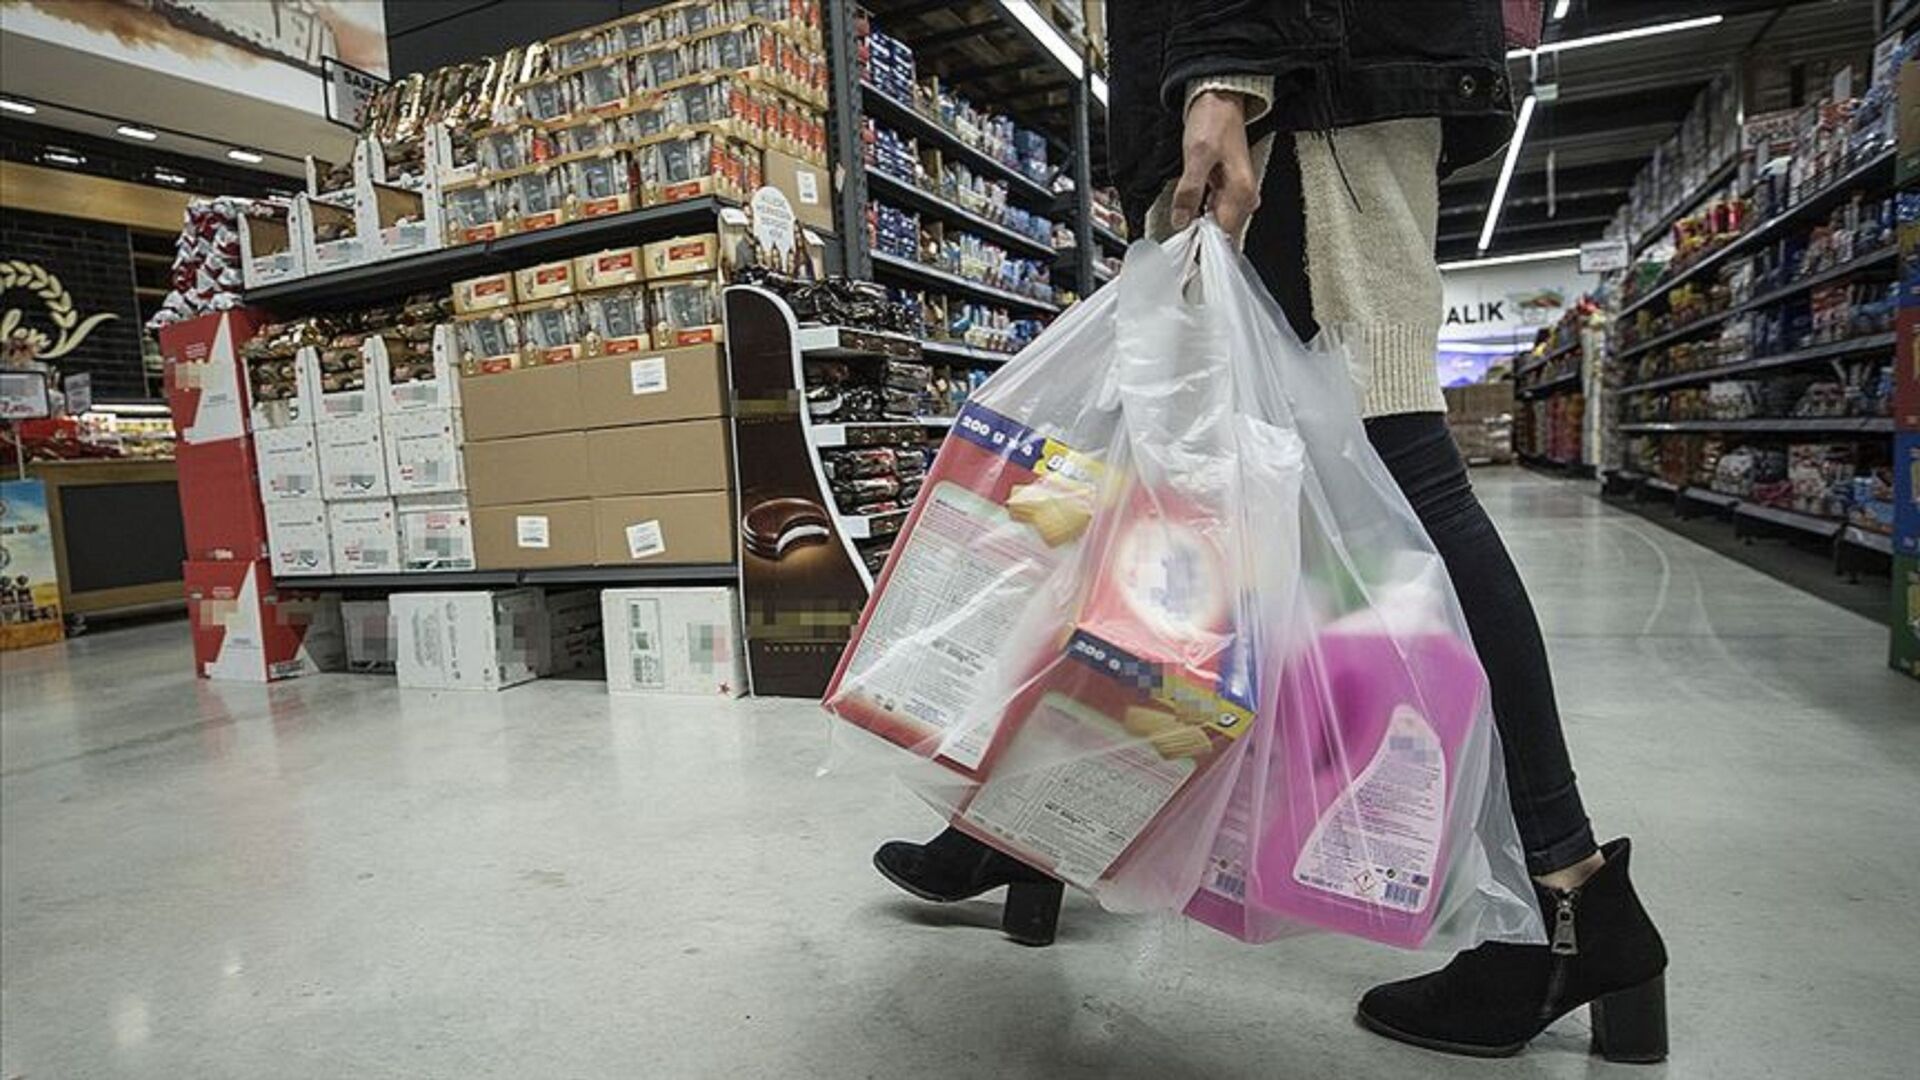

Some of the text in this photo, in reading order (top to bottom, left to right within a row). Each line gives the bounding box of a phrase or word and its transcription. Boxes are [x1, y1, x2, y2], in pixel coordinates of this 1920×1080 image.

[1446, 301, 1505, 325] ALIK
[960, 415, 991, 436] 200
[1074, 640, 1106, 661] 200
